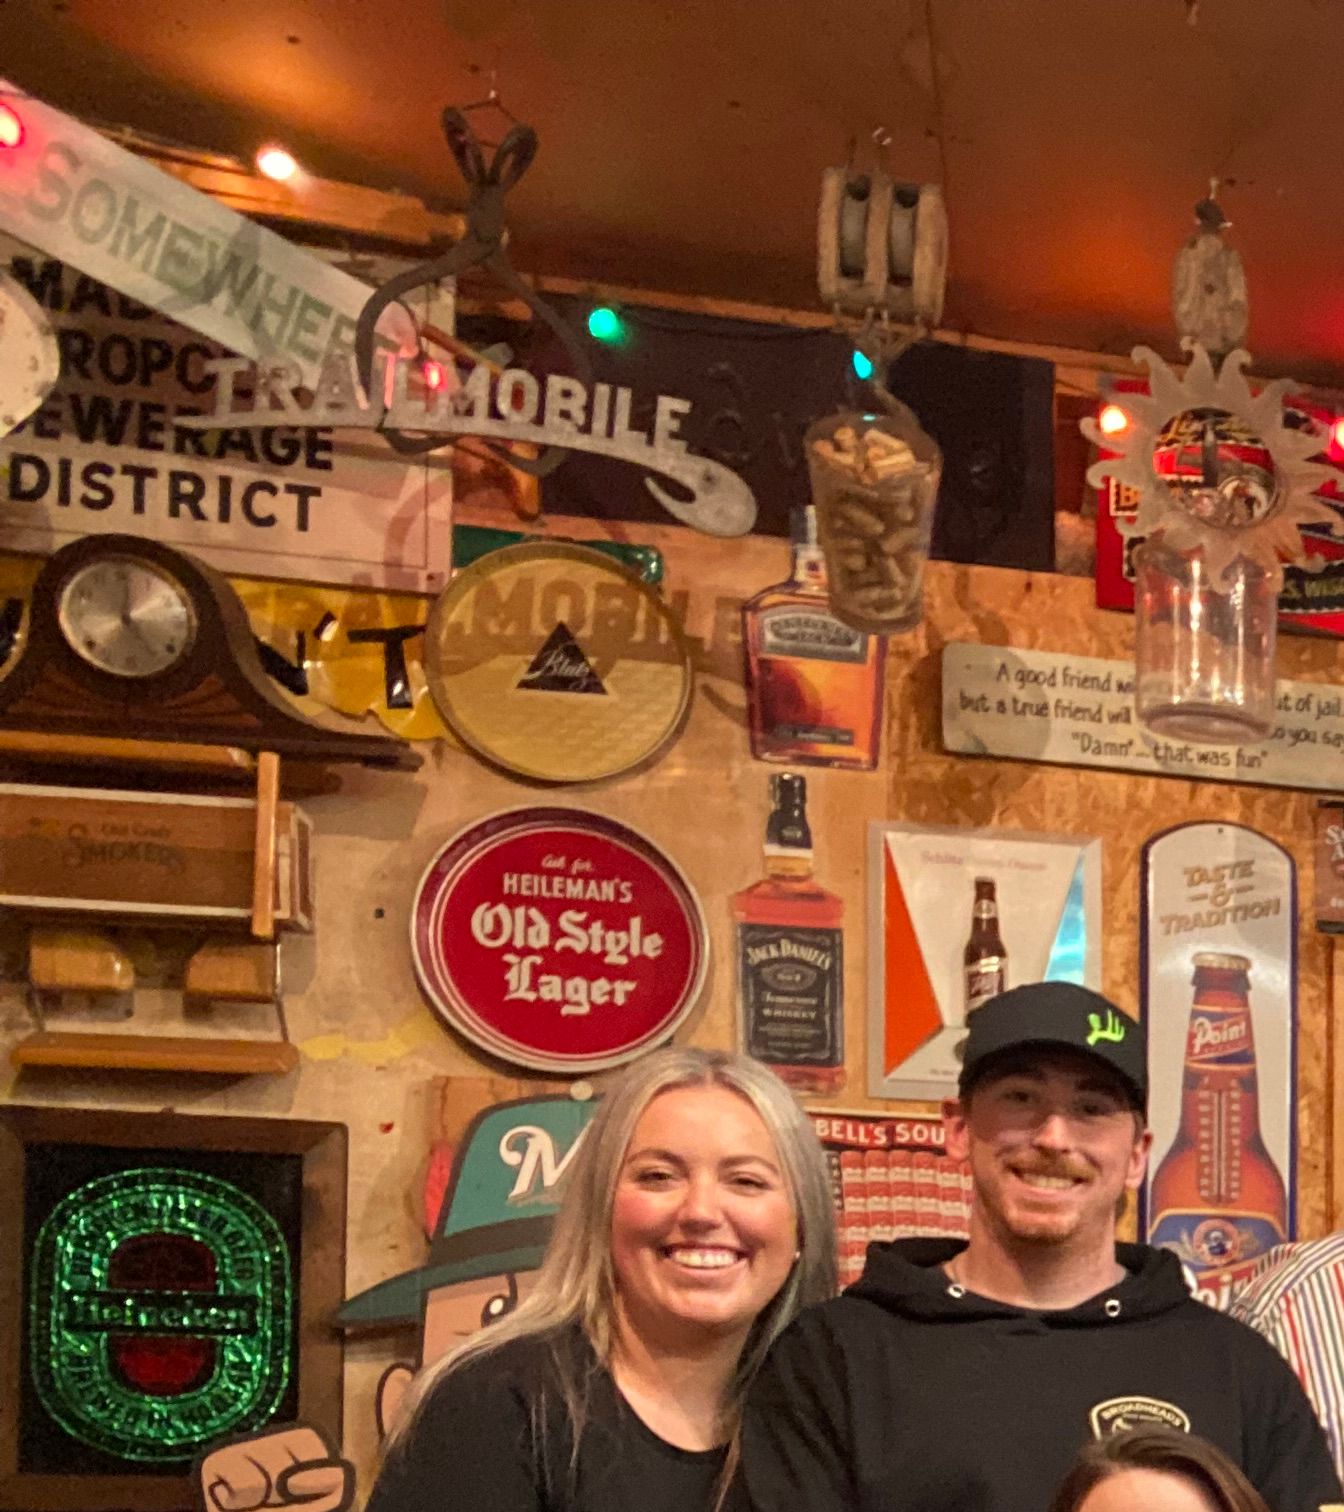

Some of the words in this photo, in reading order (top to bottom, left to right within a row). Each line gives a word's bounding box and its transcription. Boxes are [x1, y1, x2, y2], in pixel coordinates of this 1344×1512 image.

[12, 394, 334, 471] EWERAGE
[8, 452, 322, 532] DISTRICT
[996, 662, 1010, 683] A
[1014, 668, 1057, 690] good
[1061, 665, 1112, 693] friend
[959, 690, 990, 714] but
[1012, 698, 1050, 719] true
[1053, 698, 1102, 726] friend
[1107, 705, 1132, 724] will
[1286, 728, 1318, 747] you
[1153, 743, 1194, 765] that
[1196, 752, 1232, 767] was
[503, 872, 634, 904] HEILEMAN'S
[1183, 859, 1256, 888] TASTE
[470, 900, 550, 949] Old
[553, 909, 664, 965] Style
[1159, 897, 1282, 937] TRADITION
[502, 952, 637, 1017] Lager
[1192, 1016, 1246, 1054] Point
[815, 1118, 888, 1146] BELL'S
